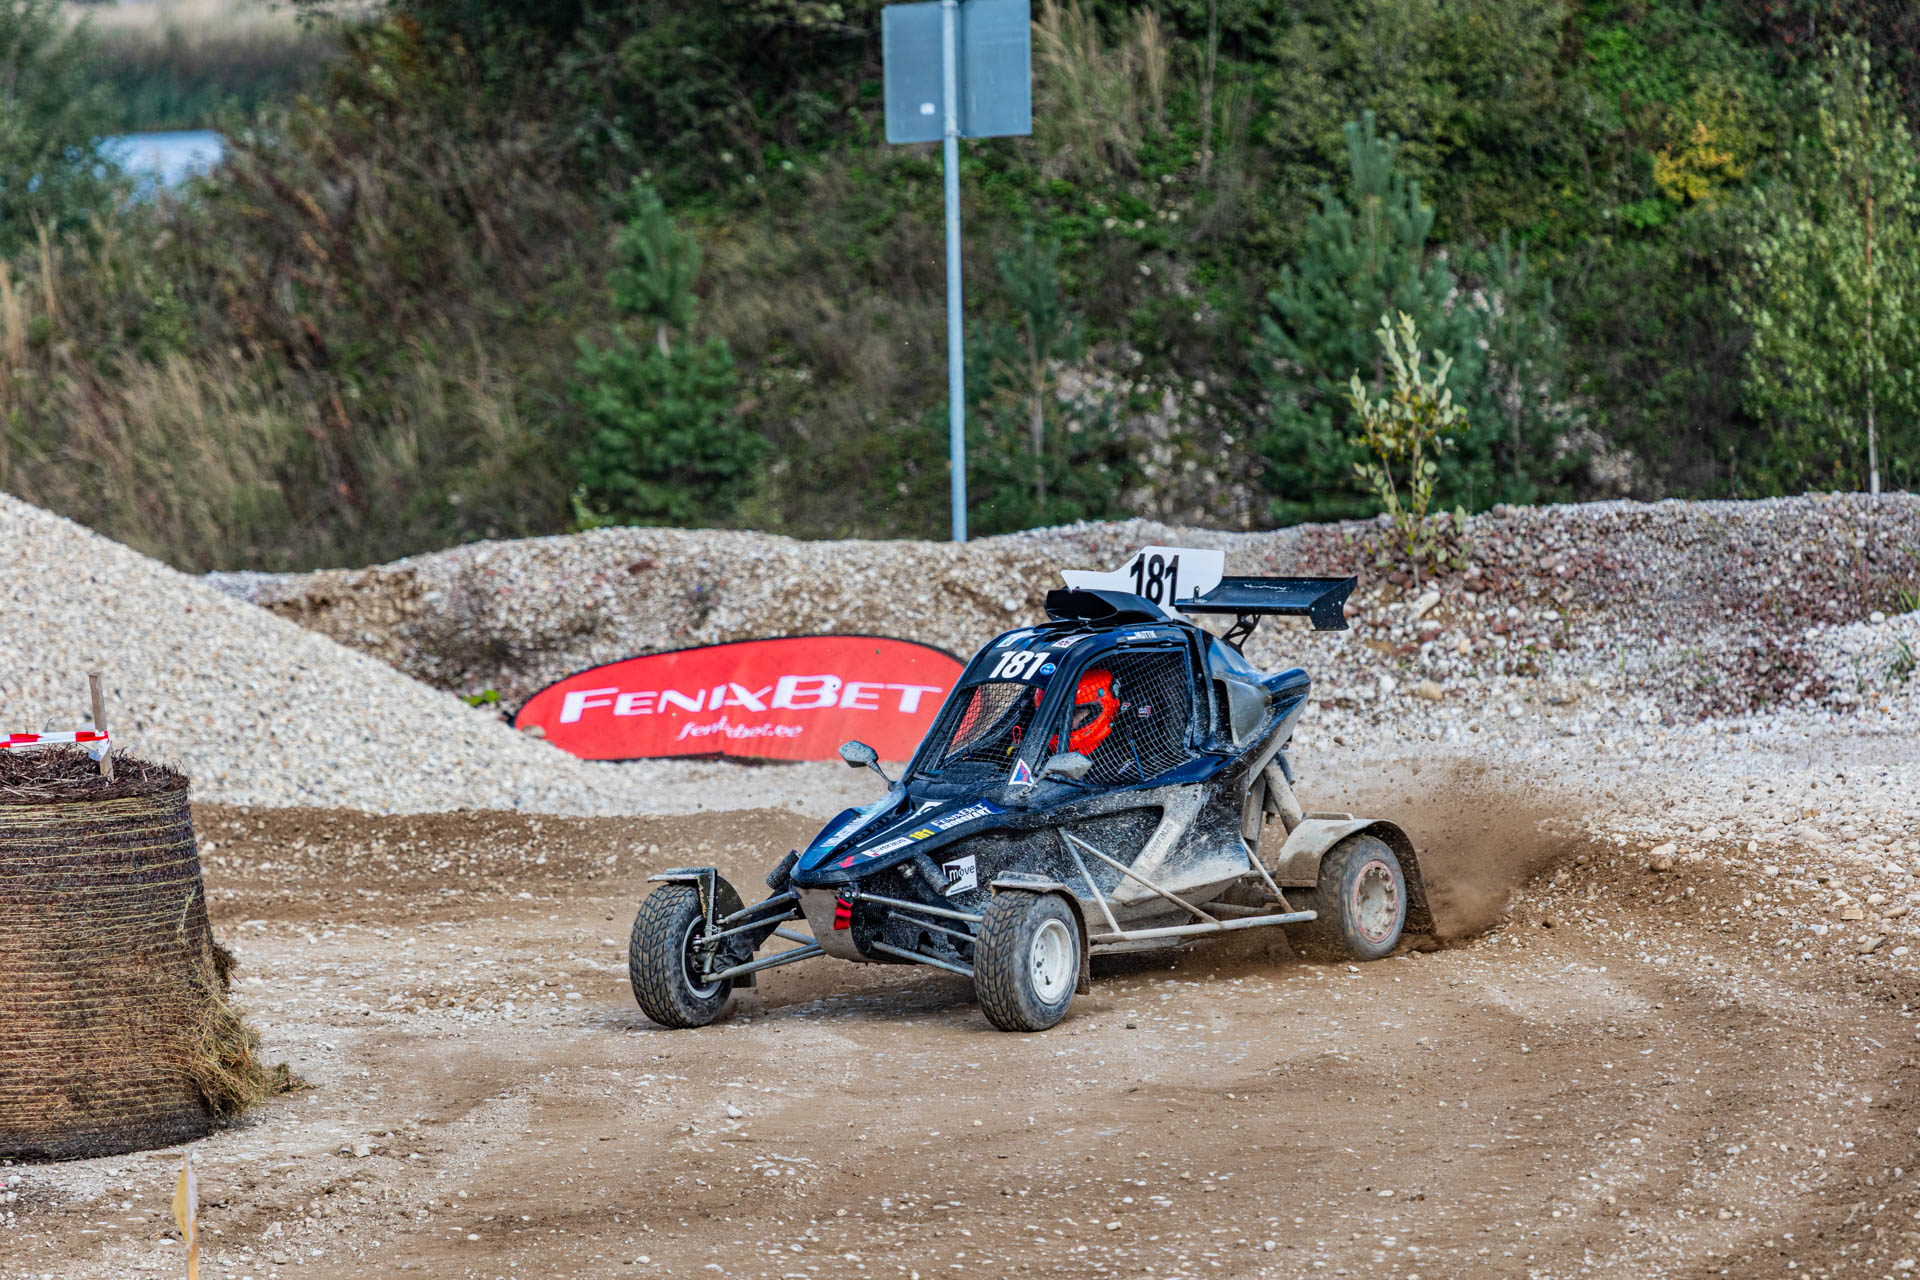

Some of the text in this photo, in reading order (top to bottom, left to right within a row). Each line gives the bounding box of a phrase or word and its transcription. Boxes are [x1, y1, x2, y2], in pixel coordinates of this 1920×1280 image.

[1130, 553, 1179, 607] 181
[988, 650, 1051, 680] 181
[559, 674, 943, 723] FENIXBET
[908, 828, 936, 841] 181
[1143, 822, 1173, 860] Everaus
[949, 865, 975, 882] move
